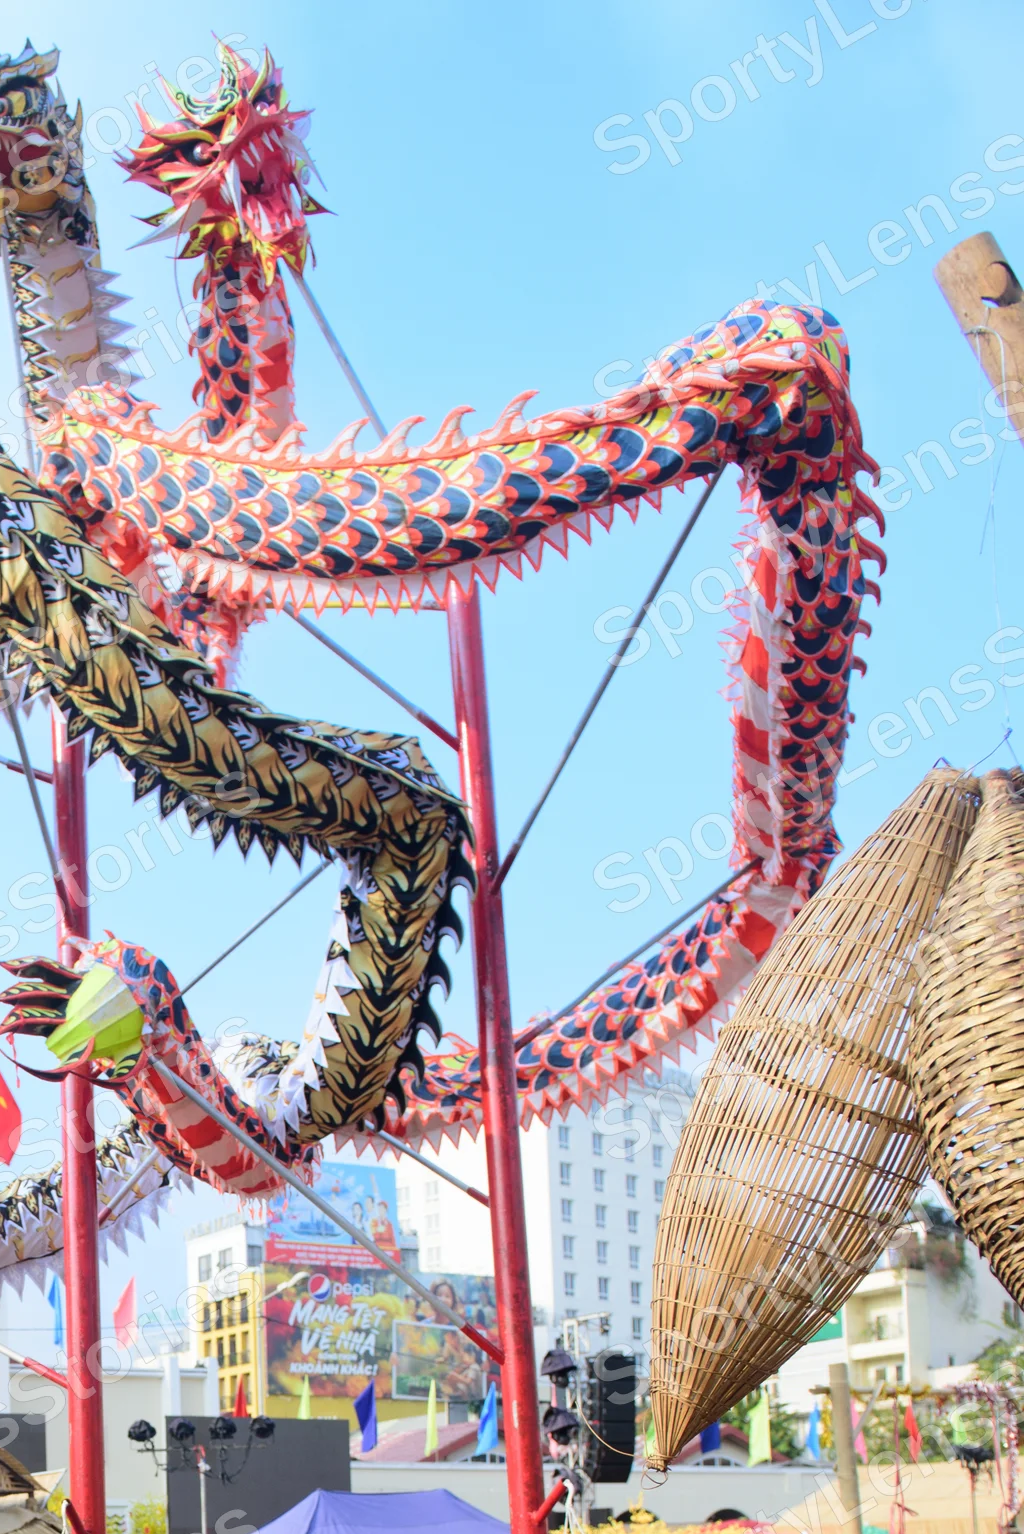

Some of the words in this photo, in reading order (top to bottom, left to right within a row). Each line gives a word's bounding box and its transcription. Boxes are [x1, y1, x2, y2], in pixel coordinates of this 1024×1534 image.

[332, 1279, 374, 1298] pepsi
[288, 1299, 349, 1327] MANG
[336, 1328, 380, 1357] NHÀ
